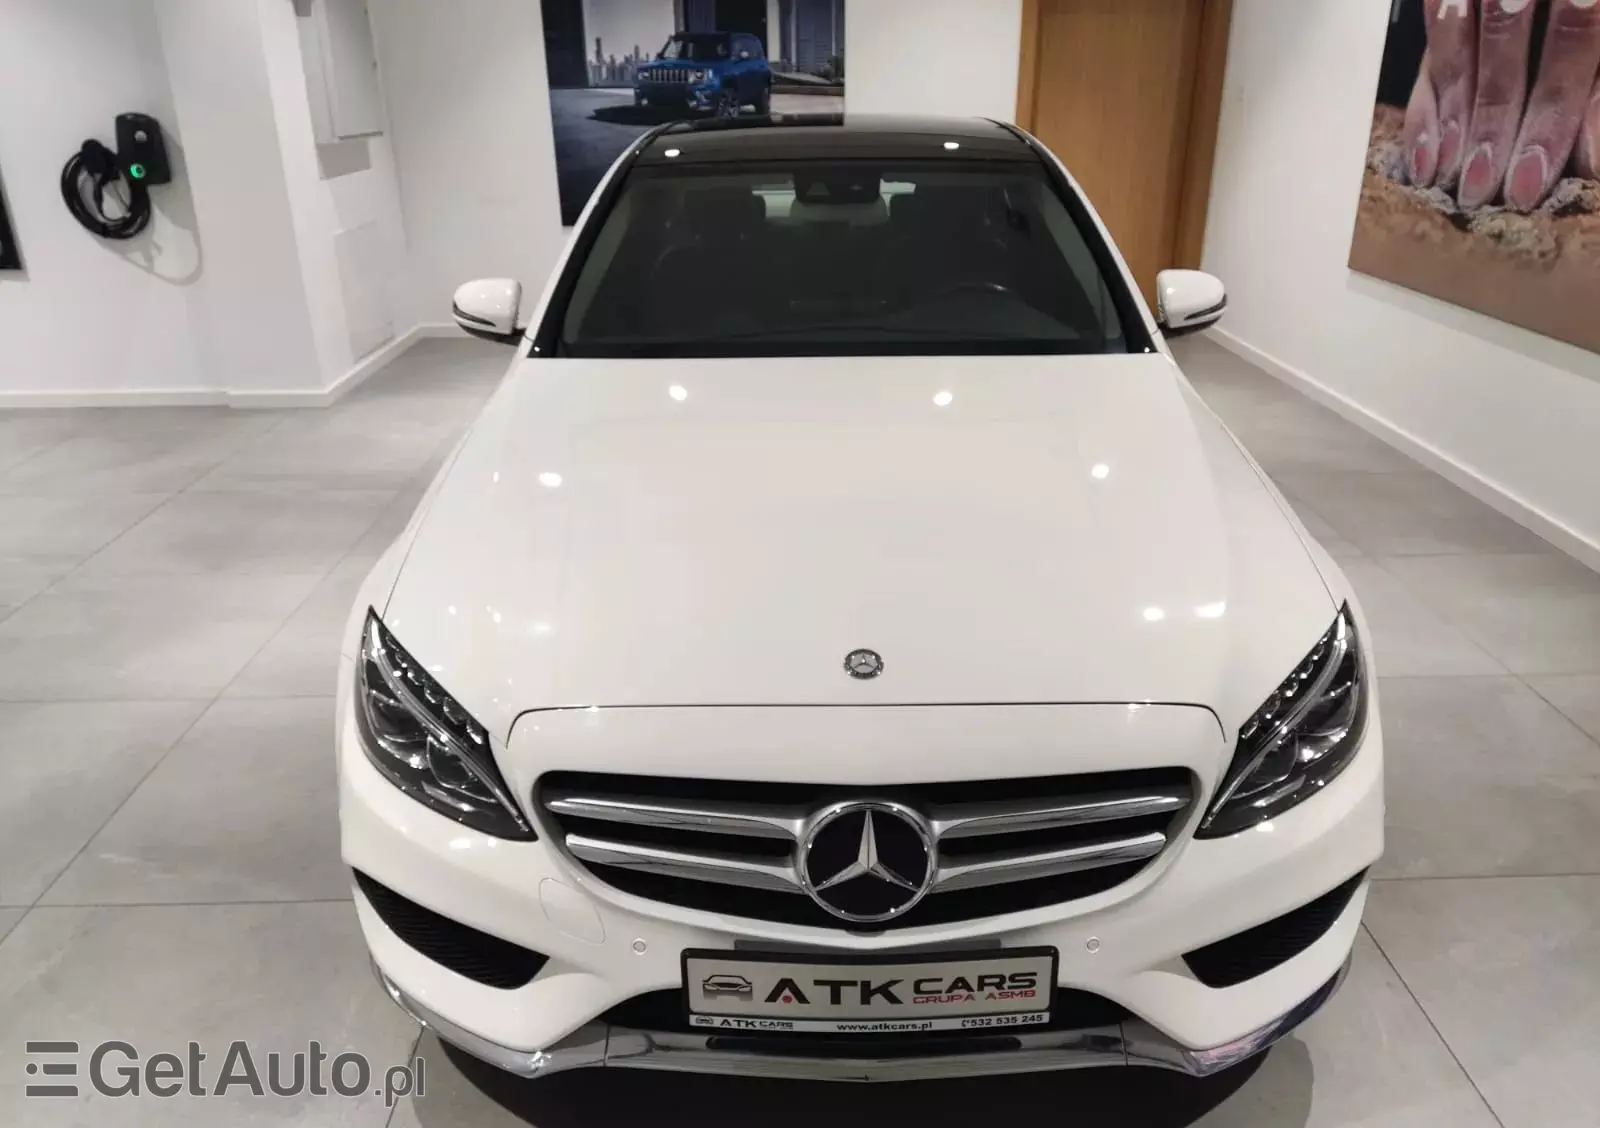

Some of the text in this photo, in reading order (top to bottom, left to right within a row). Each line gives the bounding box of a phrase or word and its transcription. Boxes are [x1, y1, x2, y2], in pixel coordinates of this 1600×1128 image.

[764, 972, 1038, 1006] ATK CARS
[912, 989, 1037, 1005] GRUPA ASMB
[720, 1018, 793, 1029] ATK CARS
[1022, 1013, 1044, 1023] 245
[836, 1021, 933, 1032] www.atkcars.pl
